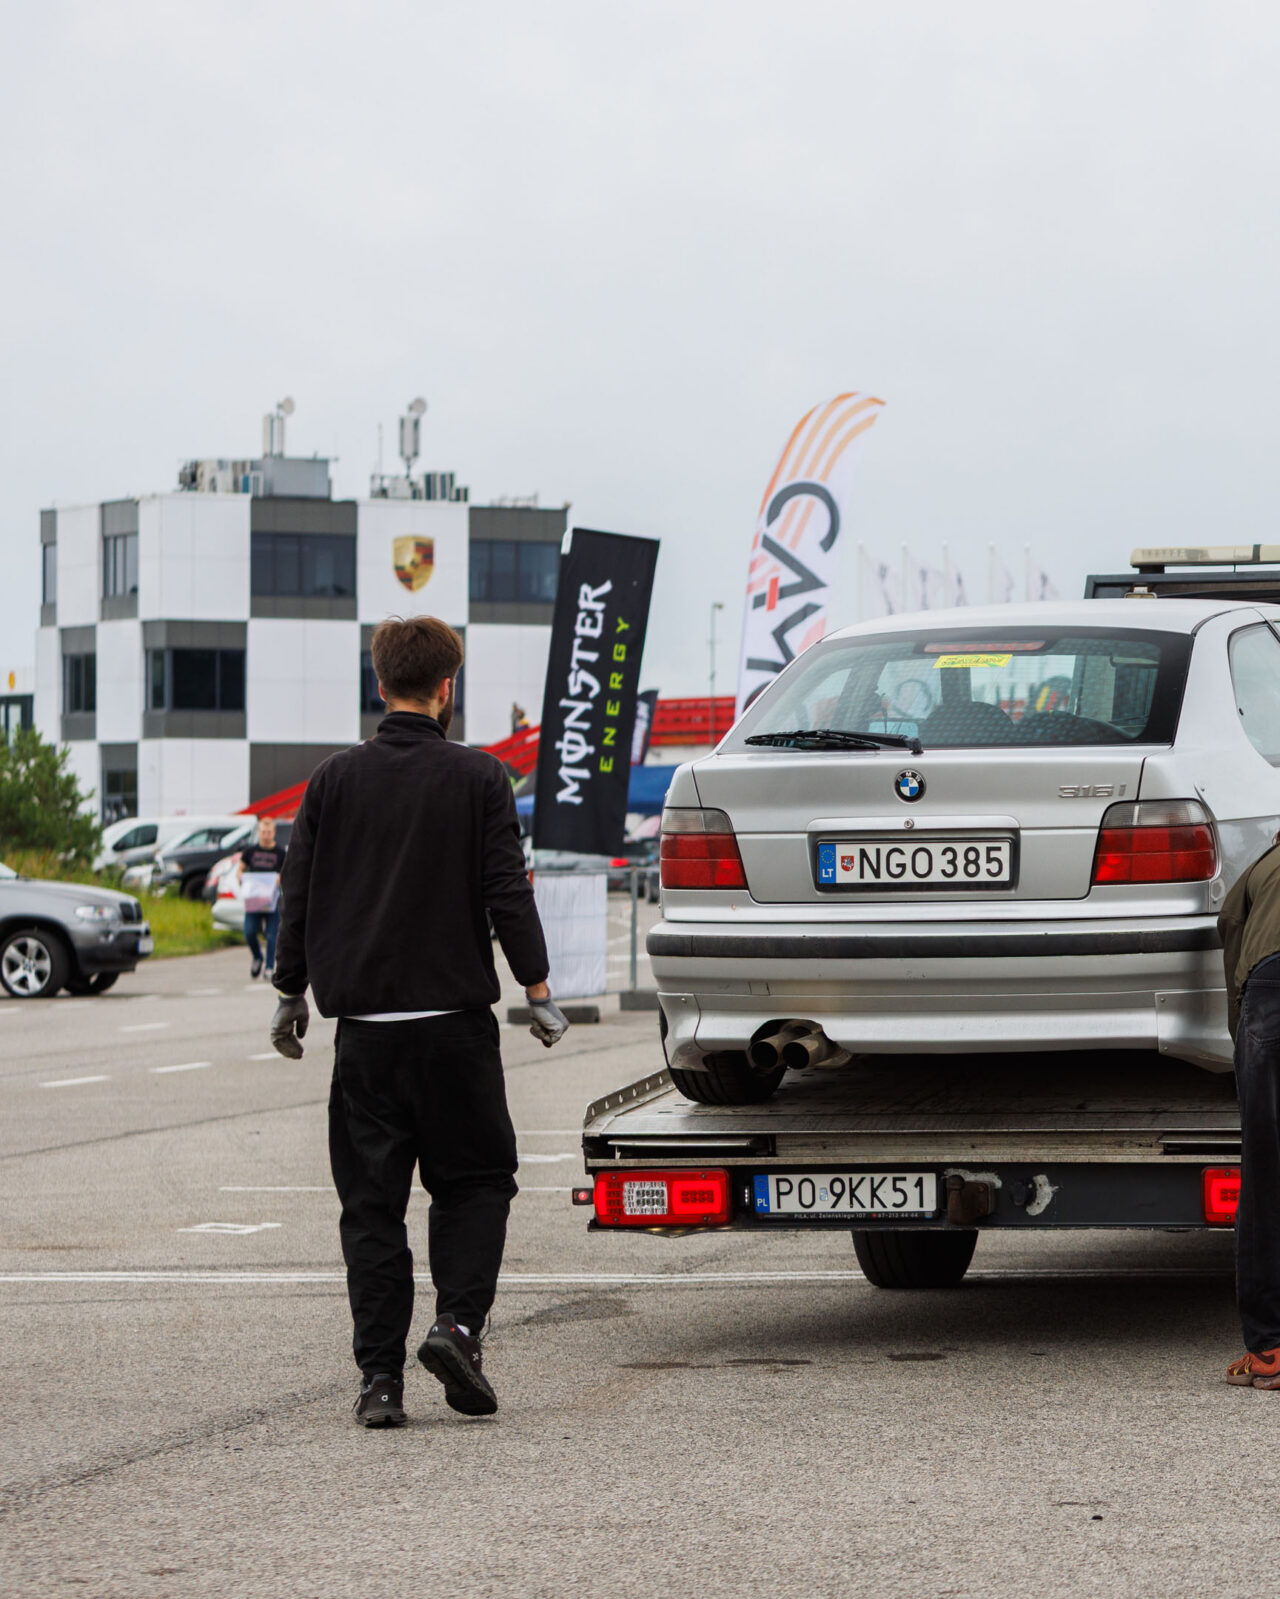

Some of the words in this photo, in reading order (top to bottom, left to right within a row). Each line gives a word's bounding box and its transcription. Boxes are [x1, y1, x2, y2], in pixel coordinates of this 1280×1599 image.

[555, 579, 613, 805] MONSTER
[599, 616, 631, 773] ENERGY
[822, 868, 834, 878] LT
[757, 1198, 768, 1207] PL
[775, 1177, 816, 1209] PO
[829, 1176, 925, 1209] 9KK51
